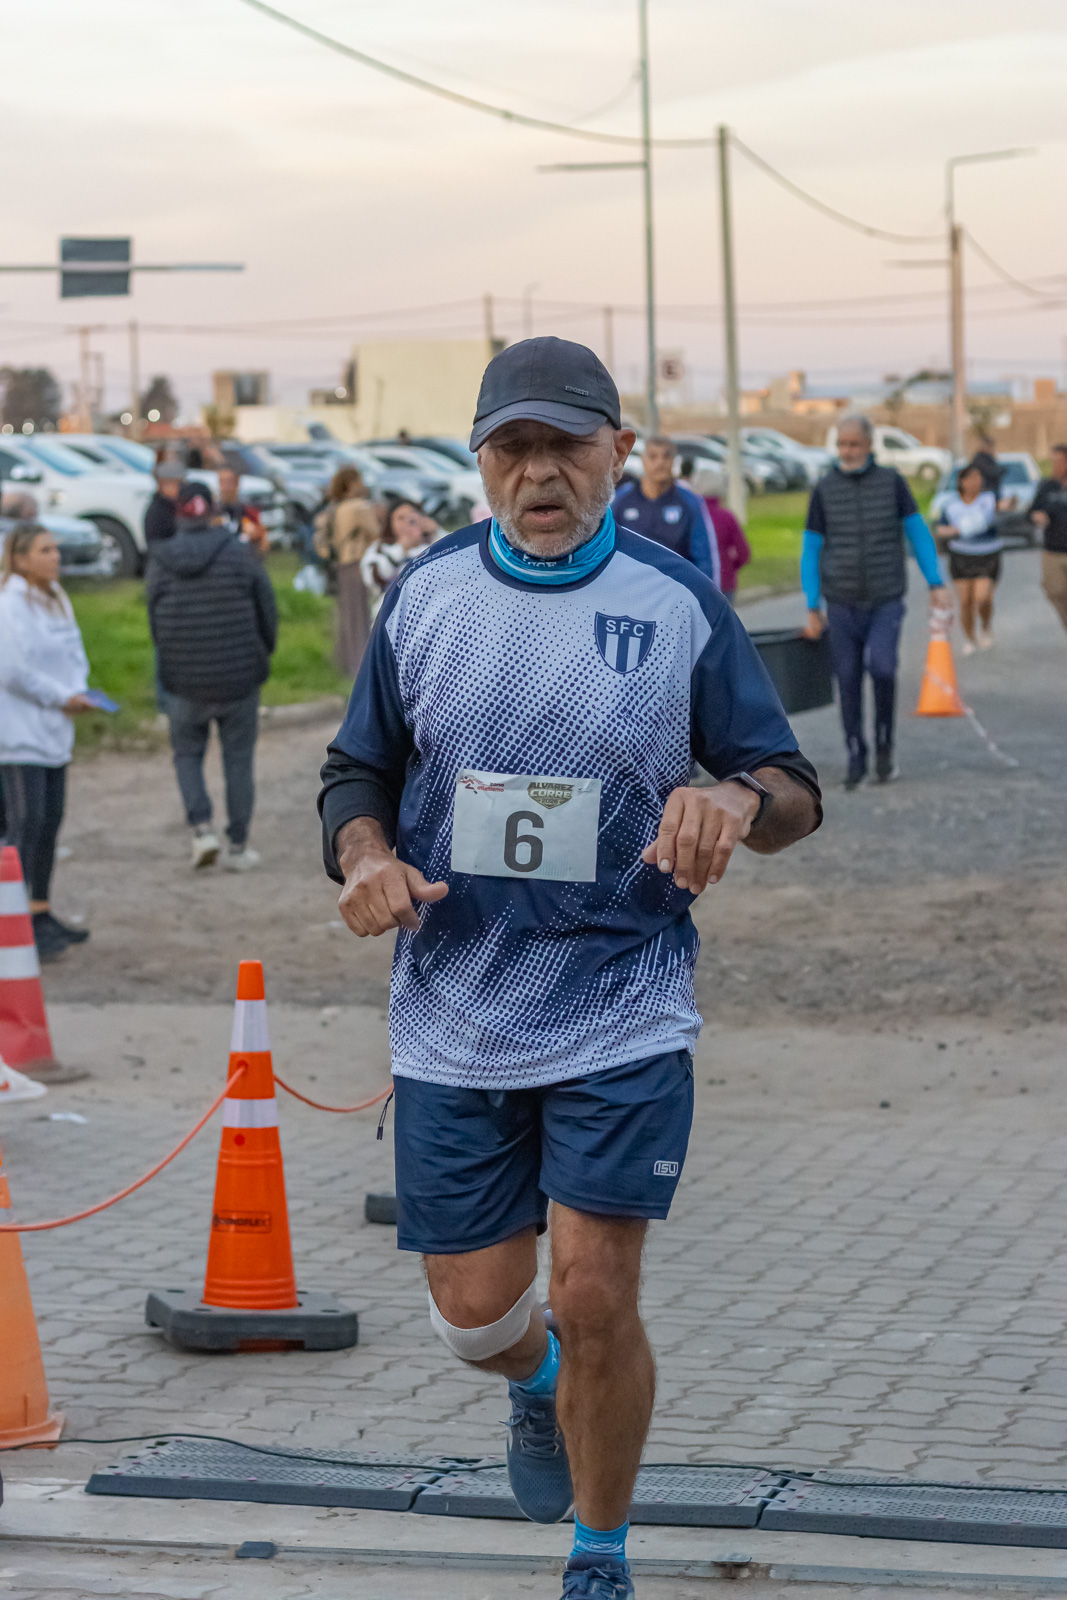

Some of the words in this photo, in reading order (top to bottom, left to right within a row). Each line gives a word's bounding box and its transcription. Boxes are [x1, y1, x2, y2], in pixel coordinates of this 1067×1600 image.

[605, 620, 645, 637] SFC
[527, 782, 575, 791] ALVAREZ
[530, 789, 572, 799] CORRE
[503, 810, 545, 873] 6
